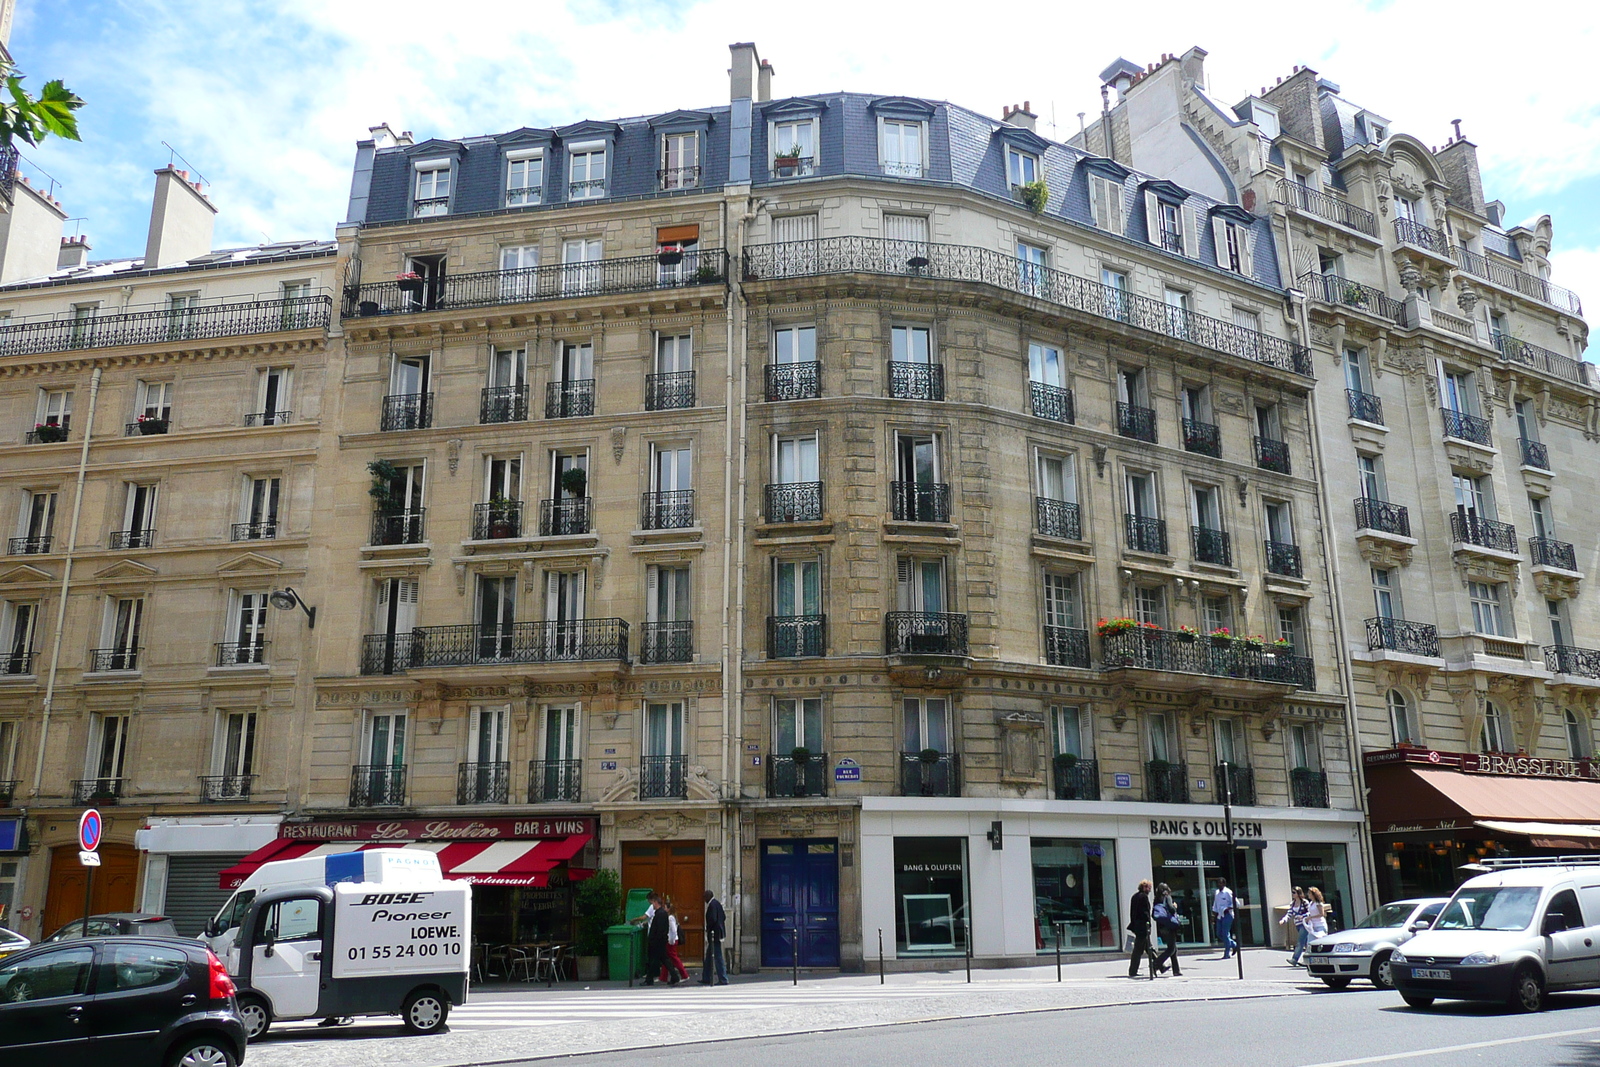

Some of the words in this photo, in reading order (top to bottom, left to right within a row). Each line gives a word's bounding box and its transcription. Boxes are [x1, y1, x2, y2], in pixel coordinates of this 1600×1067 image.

[754, 756, 760, 765] 2
[1477, 754, 1581, 777] BRASSERIE
[283, 824, 359, 838] RESTAURANT
[420, 821, 501, 839] Lutin
[514, 821, 540, 835] BAR
[543, 822, 550, 834] à
[555, 821, 584, 834] VINS
[1150, 820, 1189, 835] BANG
[1193, 820, 1202, 835] &
[465, 875, 535, 885] Restaurant
[349, 891, 434, 906] BOSE
[371, 909, 451, 922] Pioneer
[348, 947, 366, 960] 01
[372, 946, 391, 959] 55
[395, 944, 415, 958] 24
[419, 943, 438, 956] 00
[443, 942, 461, 955] 10
